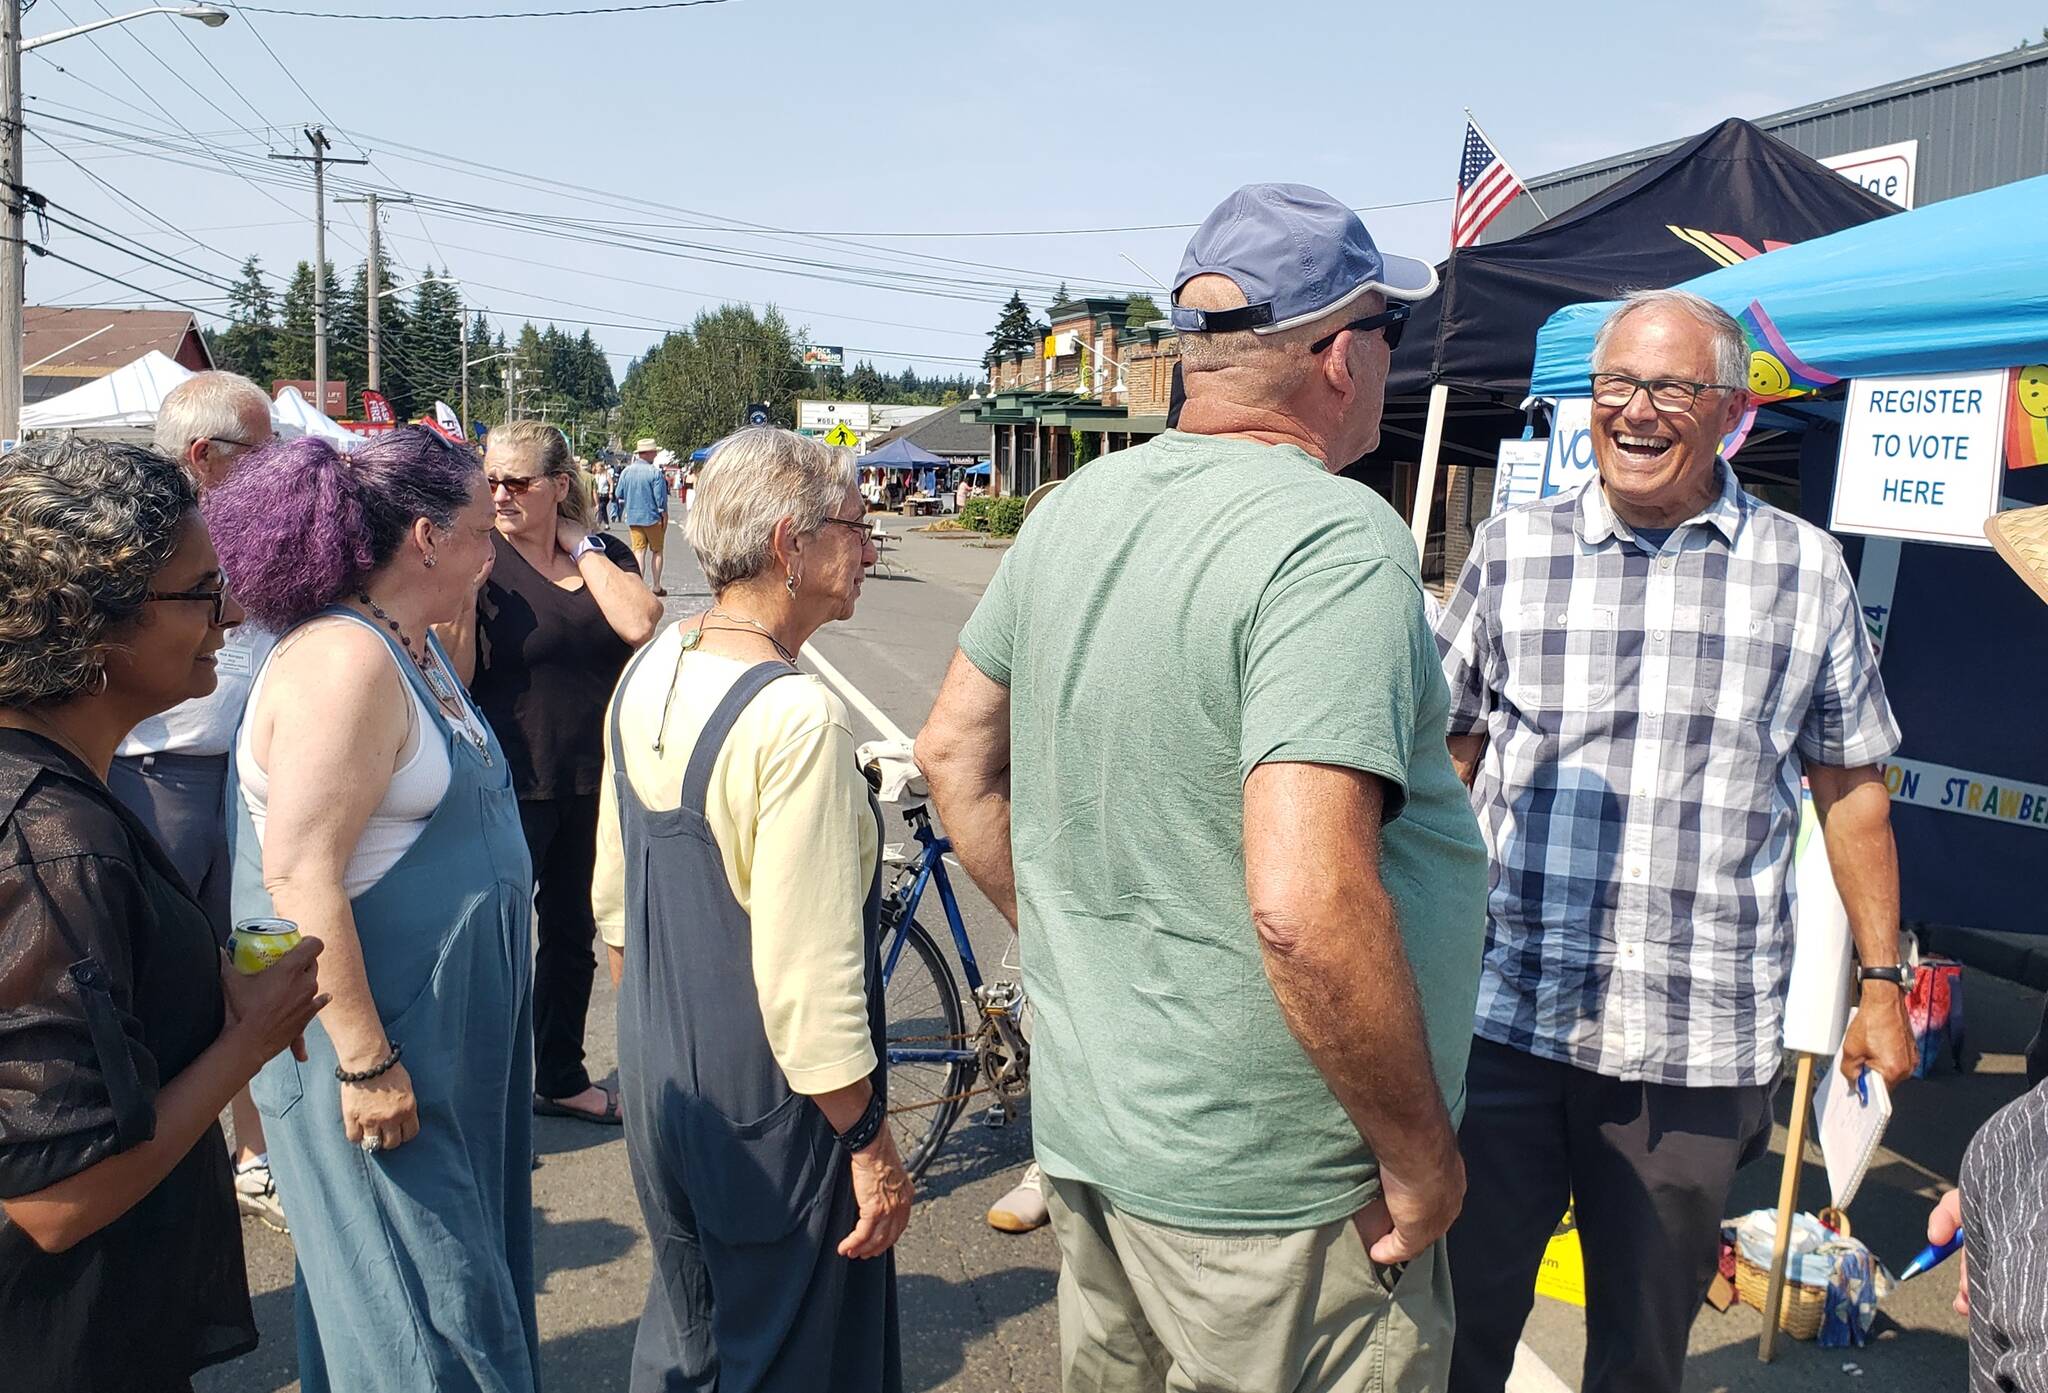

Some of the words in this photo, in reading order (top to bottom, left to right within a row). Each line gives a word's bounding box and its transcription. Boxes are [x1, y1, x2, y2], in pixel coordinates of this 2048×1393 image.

[369, 400, 382, 423] FIRE
[1869, 389, 1983, 414] REGISTER
[1872, 434, 1901, 457] TO
[1908, 434, 1969, 460] VOTE
[1882, 478, 1945, 505] HERE
[1940, 777, 2048, 825] STRAWBE
